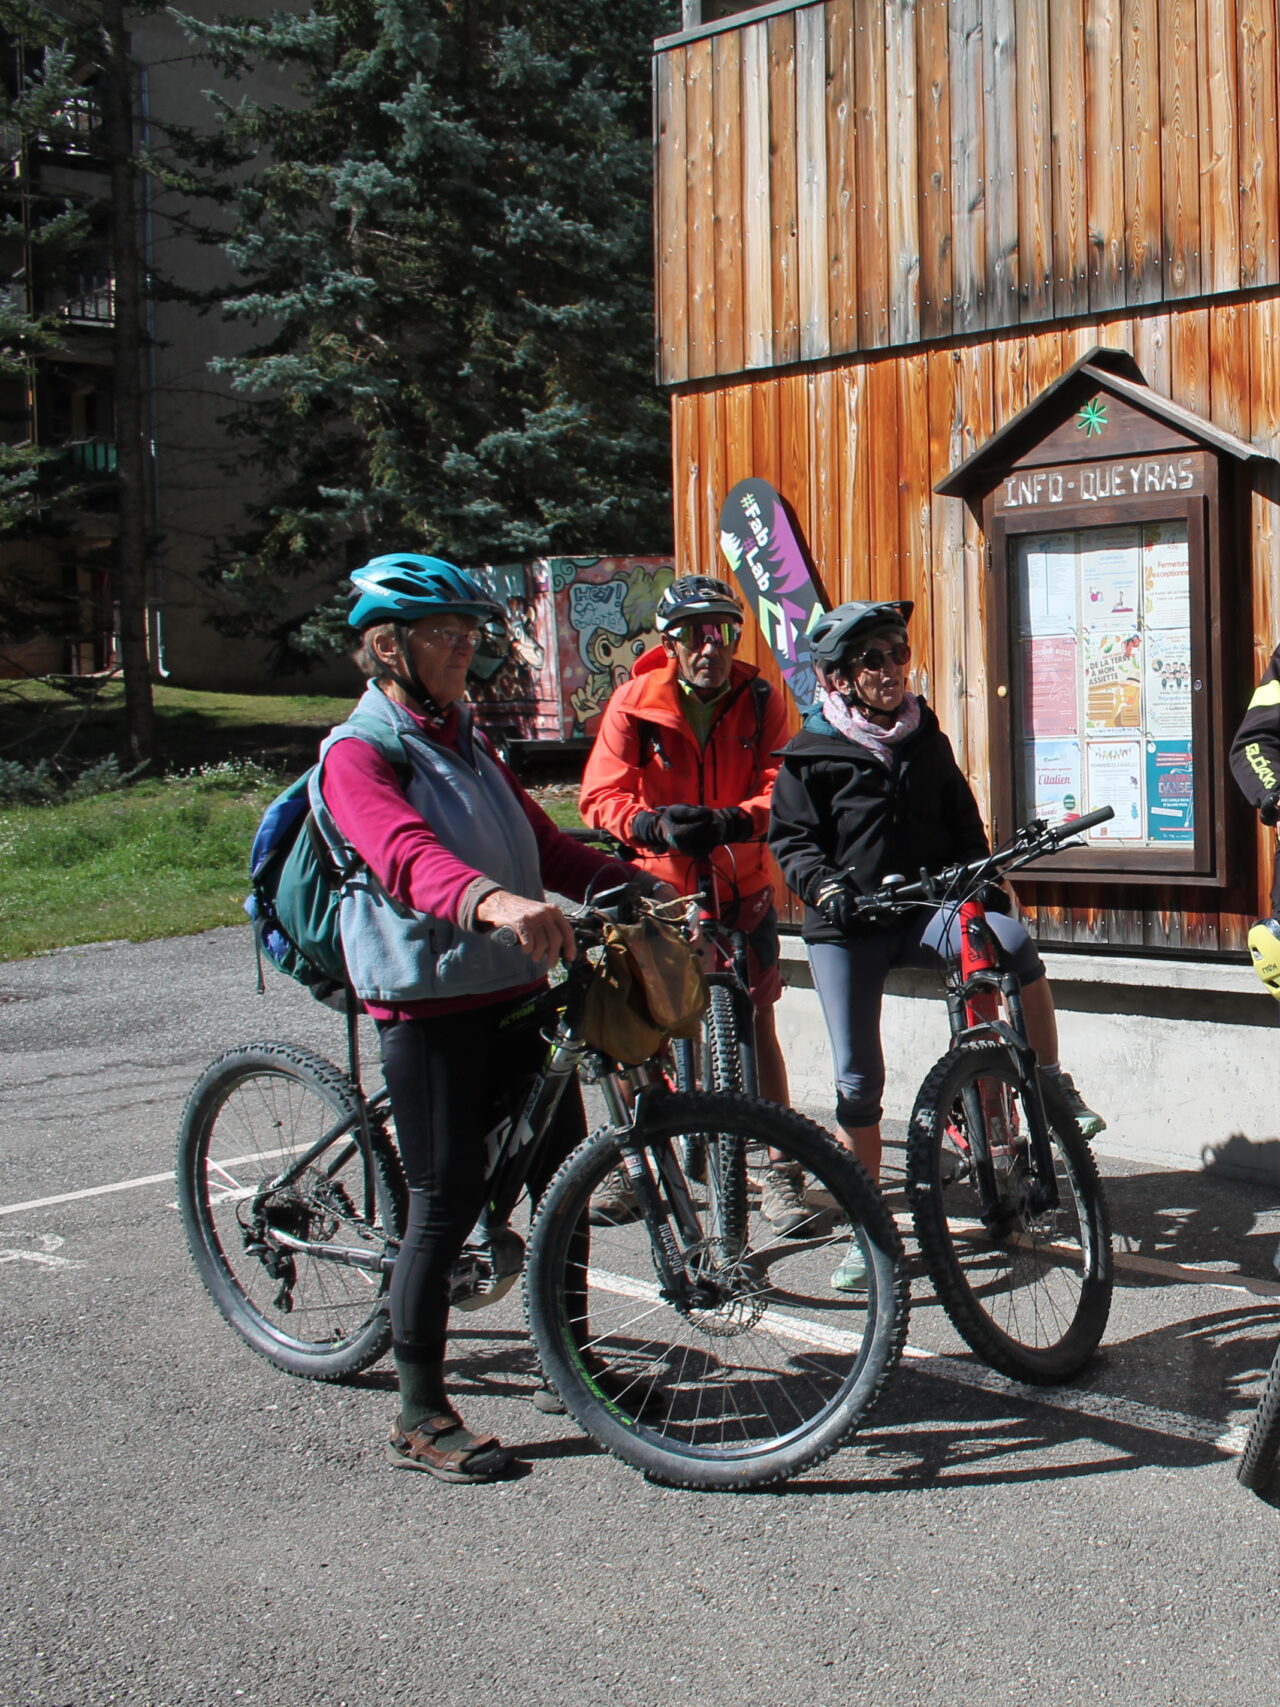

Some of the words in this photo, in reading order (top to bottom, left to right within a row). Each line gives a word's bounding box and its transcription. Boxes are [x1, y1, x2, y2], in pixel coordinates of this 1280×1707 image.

[1003, 473, 1063, 507] INFO
[1080, 458, 1194, 501] QUEYRAS
[740, 493, 769, 547] #Fab
